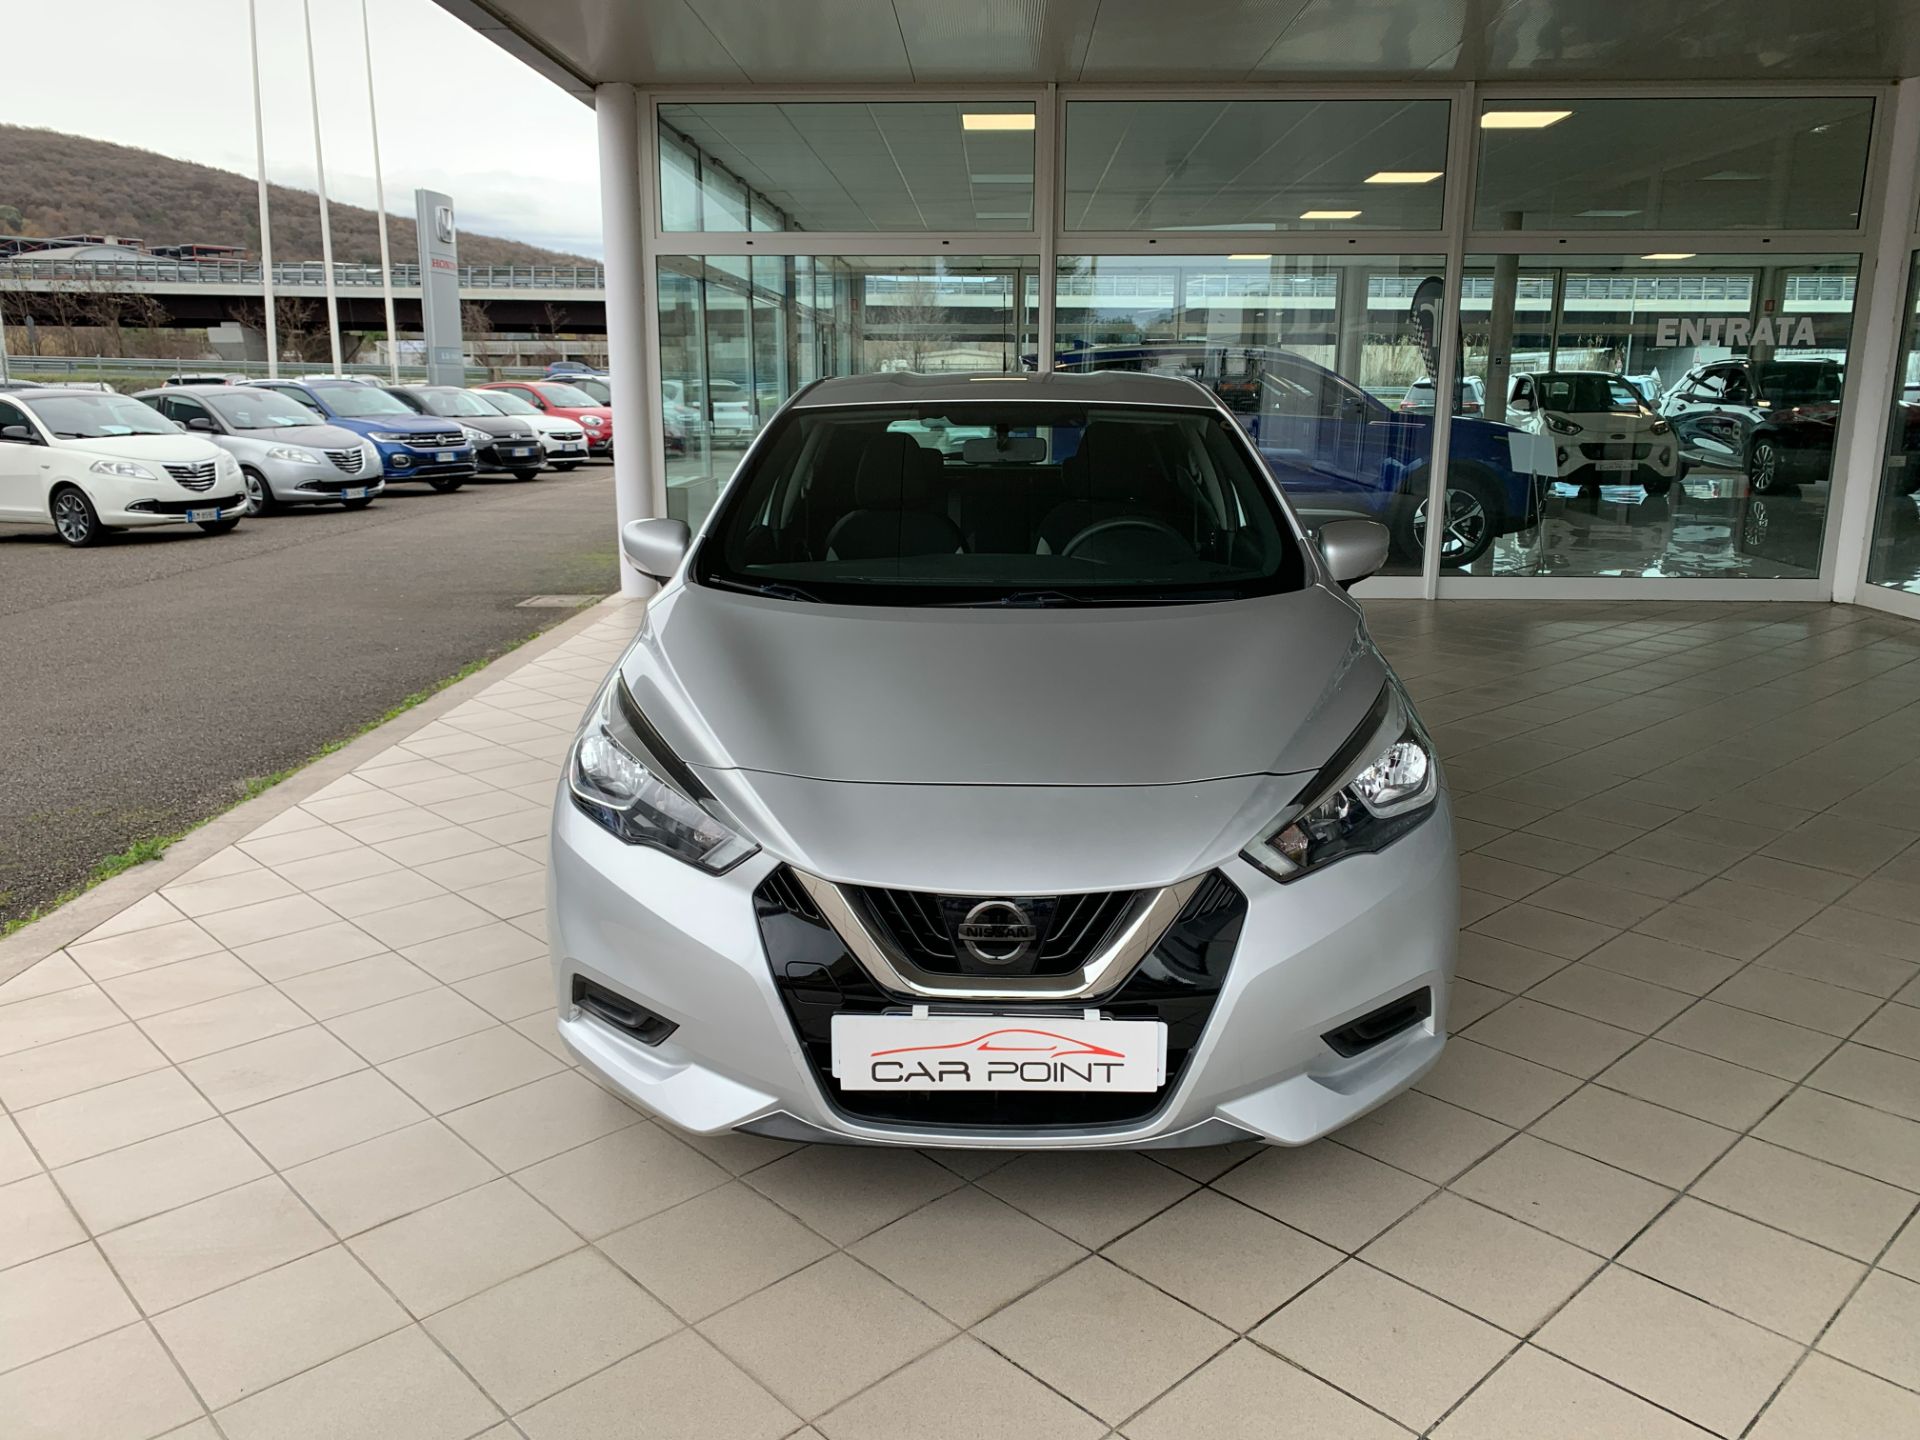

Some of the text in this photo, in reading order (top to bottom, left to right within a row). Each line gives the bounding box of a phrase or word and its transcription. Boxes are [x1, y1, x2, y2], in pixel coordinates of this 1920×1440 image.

[431, 258, 457, 271] HON
[1656, 316, 1816, 347] ENTRATA
[966, 926, 1029, 938] NISSAN
[871, 1061, 1124, 1084] CAR POINT
